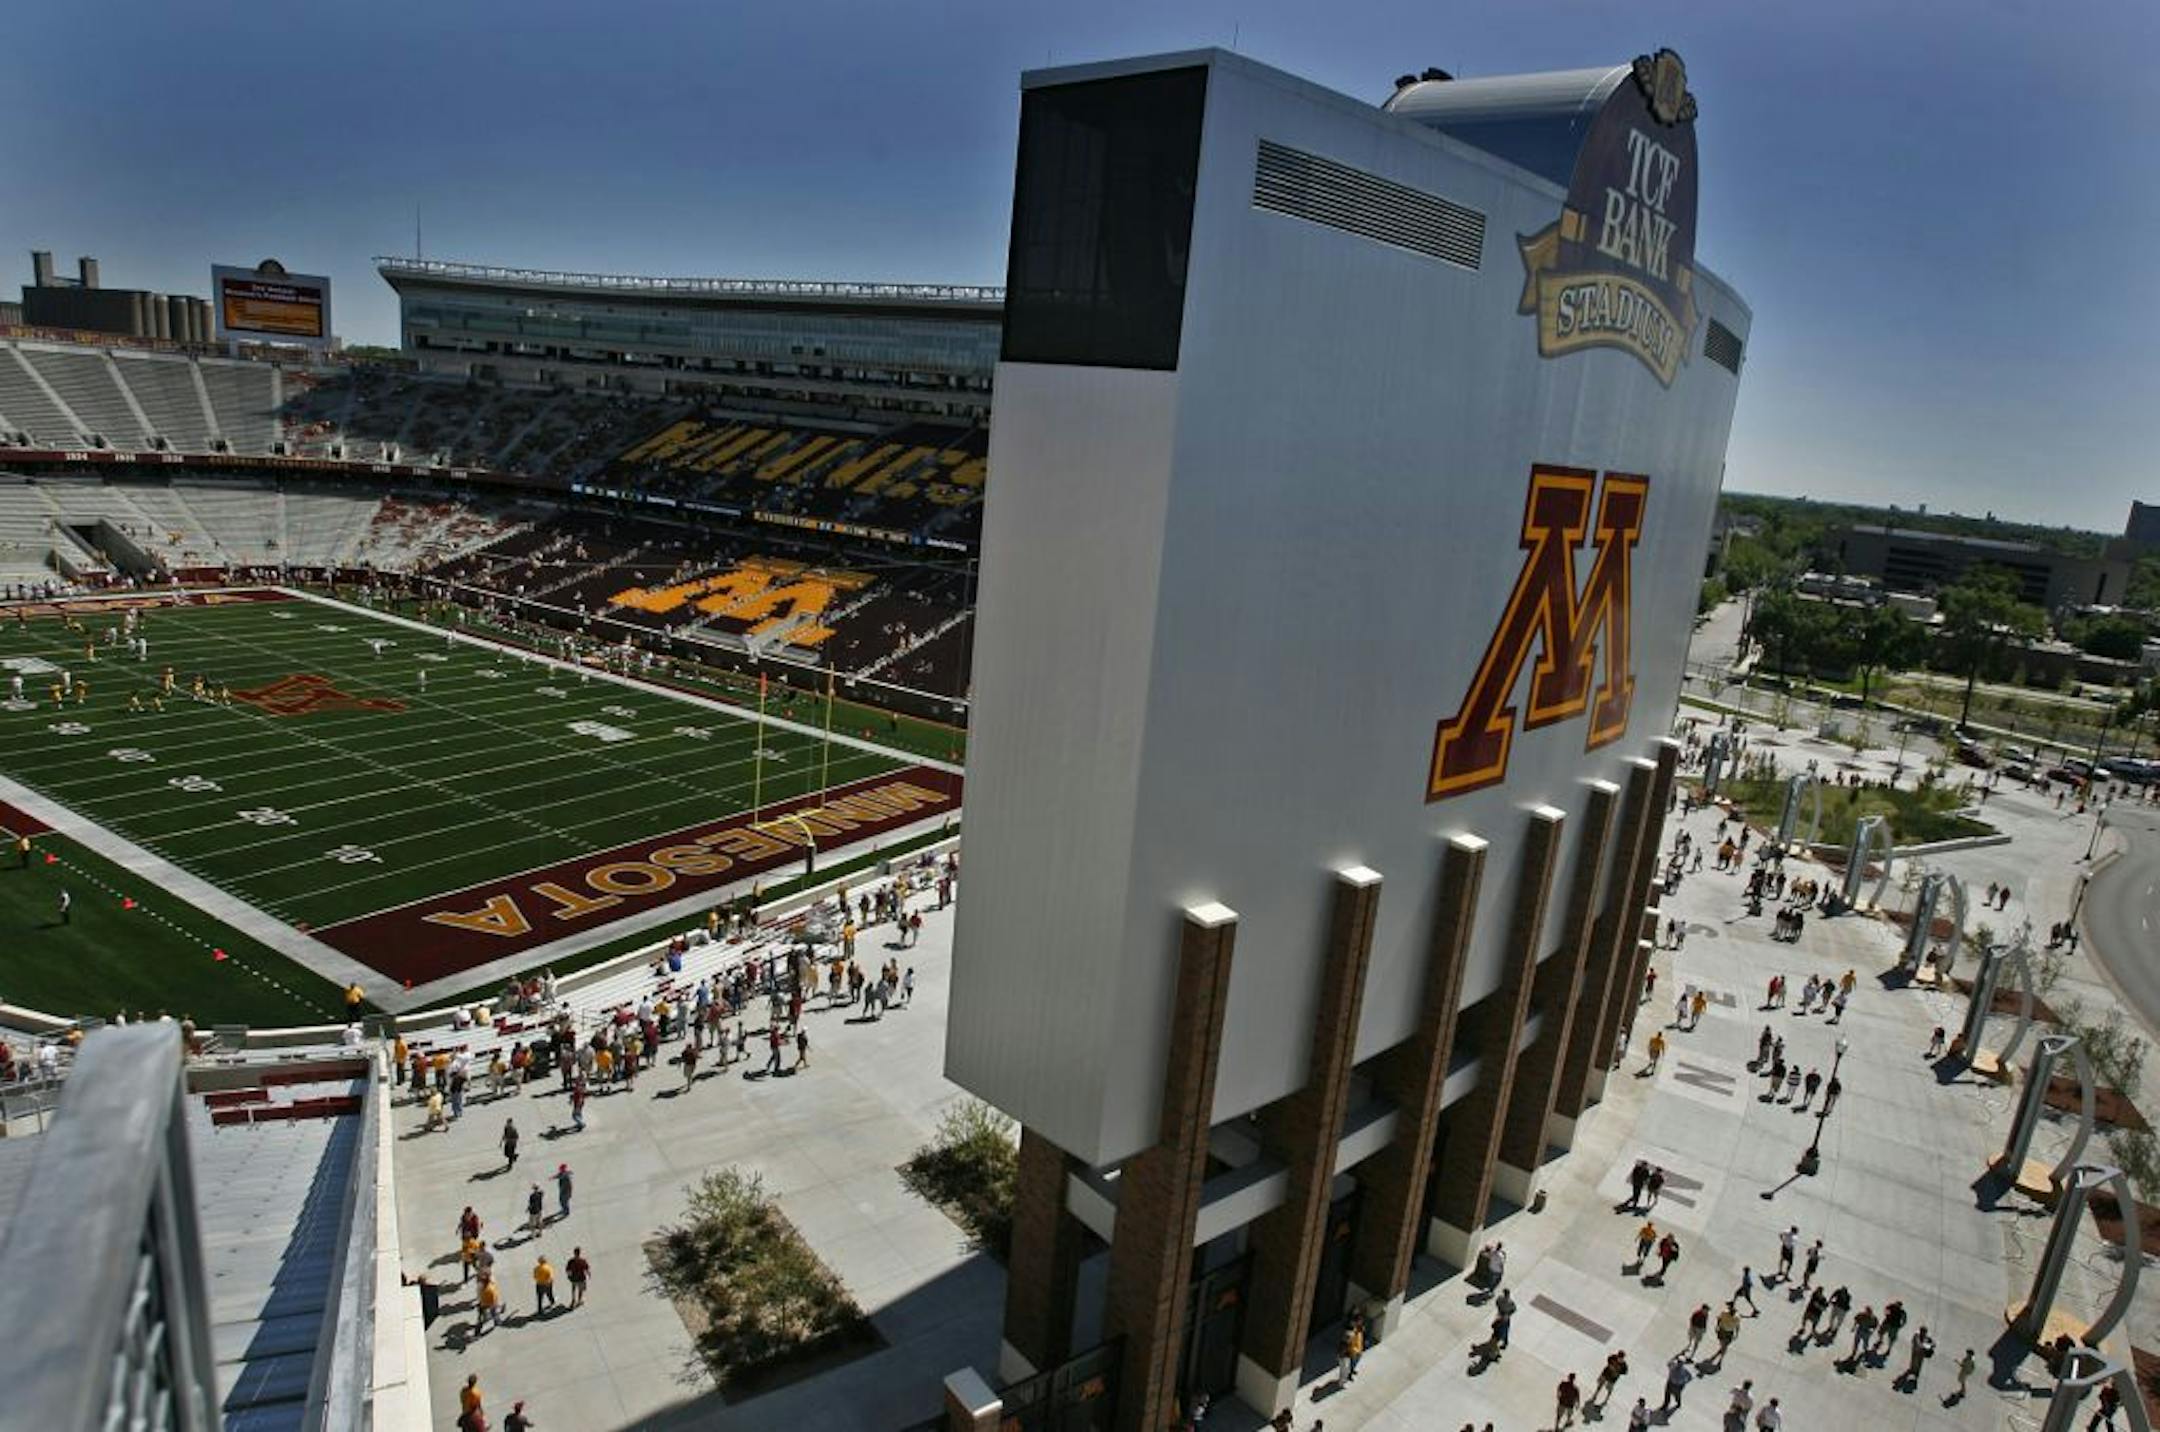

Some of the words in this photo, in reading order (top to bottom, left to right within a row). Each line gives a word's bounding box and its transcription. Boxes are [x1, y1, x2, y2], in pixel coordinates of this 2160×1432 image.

[1625, 129, 1681, 214] TCF
[1596, 187, 1679, 282] BANK
[1556, 281, 1674, 369] STADIUM
[1425, 464, 1650, 804] M
[422, 781, 952, 938] MINNESOTA
